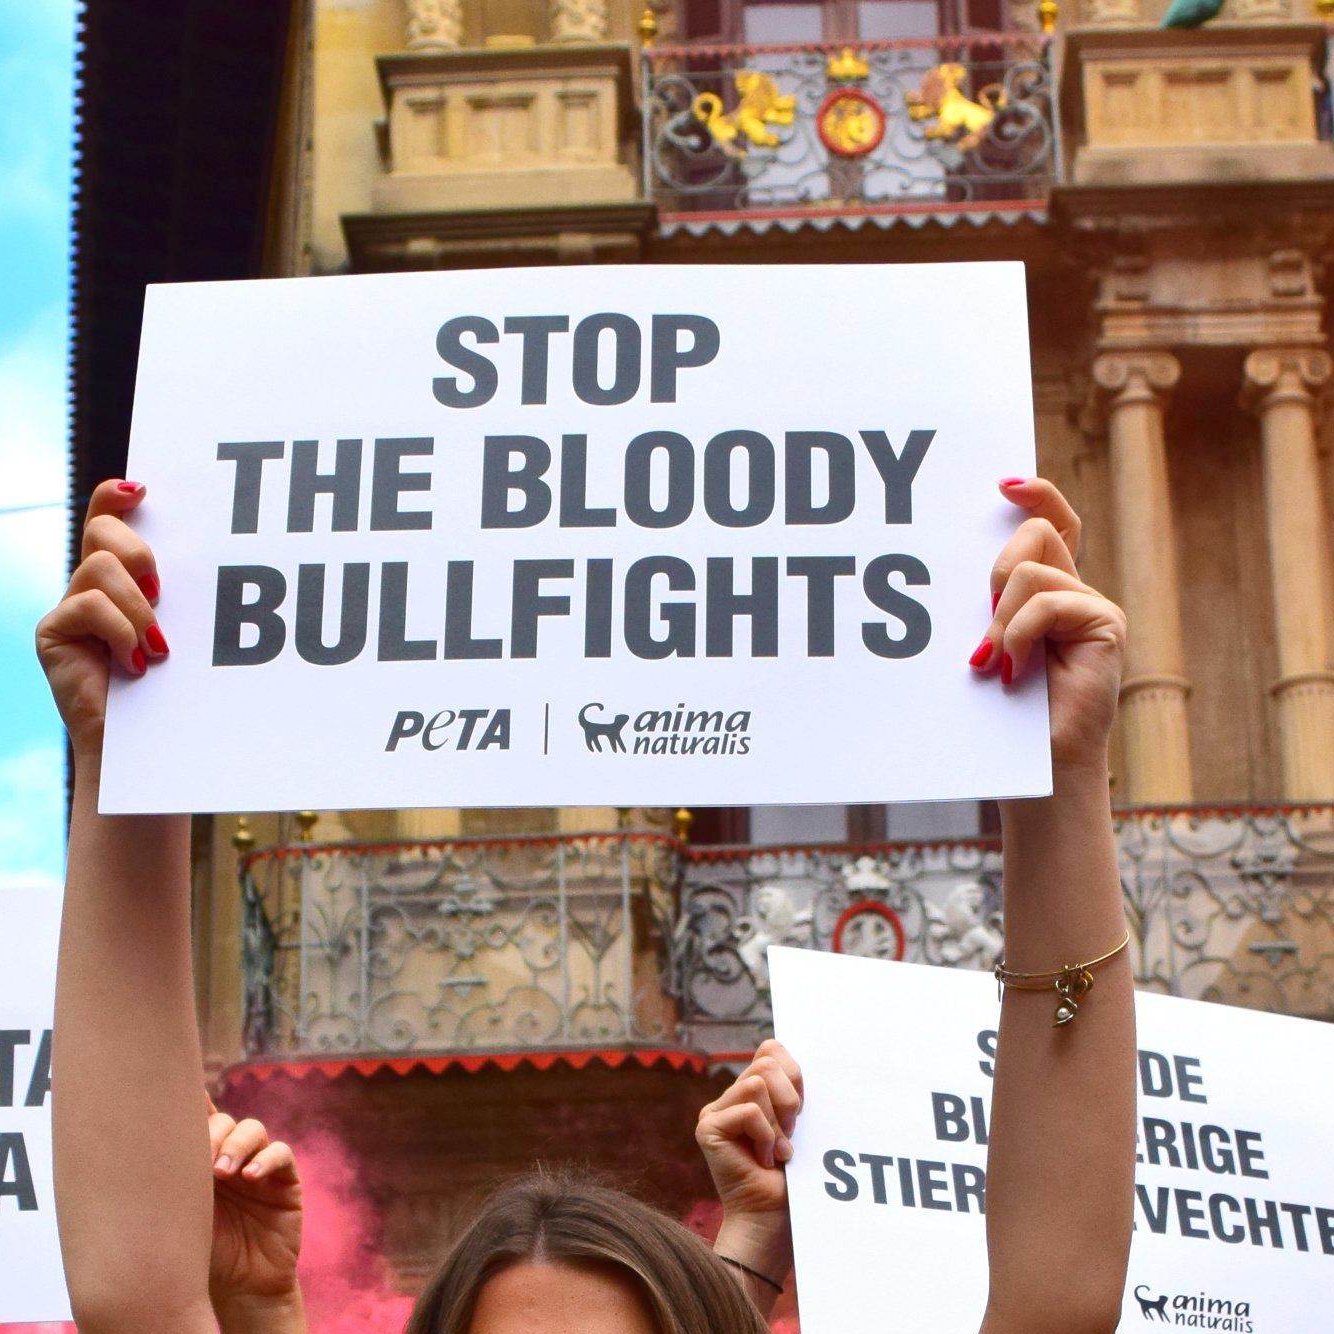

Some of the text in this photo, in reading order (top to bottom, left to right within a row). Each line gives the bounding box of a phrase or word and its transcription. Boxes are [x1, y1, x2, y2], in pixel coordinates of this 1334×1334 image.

[432, 313, 720, 409] STOP
[217, 429, 936, 534] THE BLOODY
[212, 553, 932, 667] BULLFIGHTS
[633, 702, 751, 732] anima
[632, 729, 751, 756] naturalis
[1138, 1049, 1208, 1104] DE
[1172, 1293, 1250, 1318] anima
[1174, 1311, 1253, 1334] naturalis
